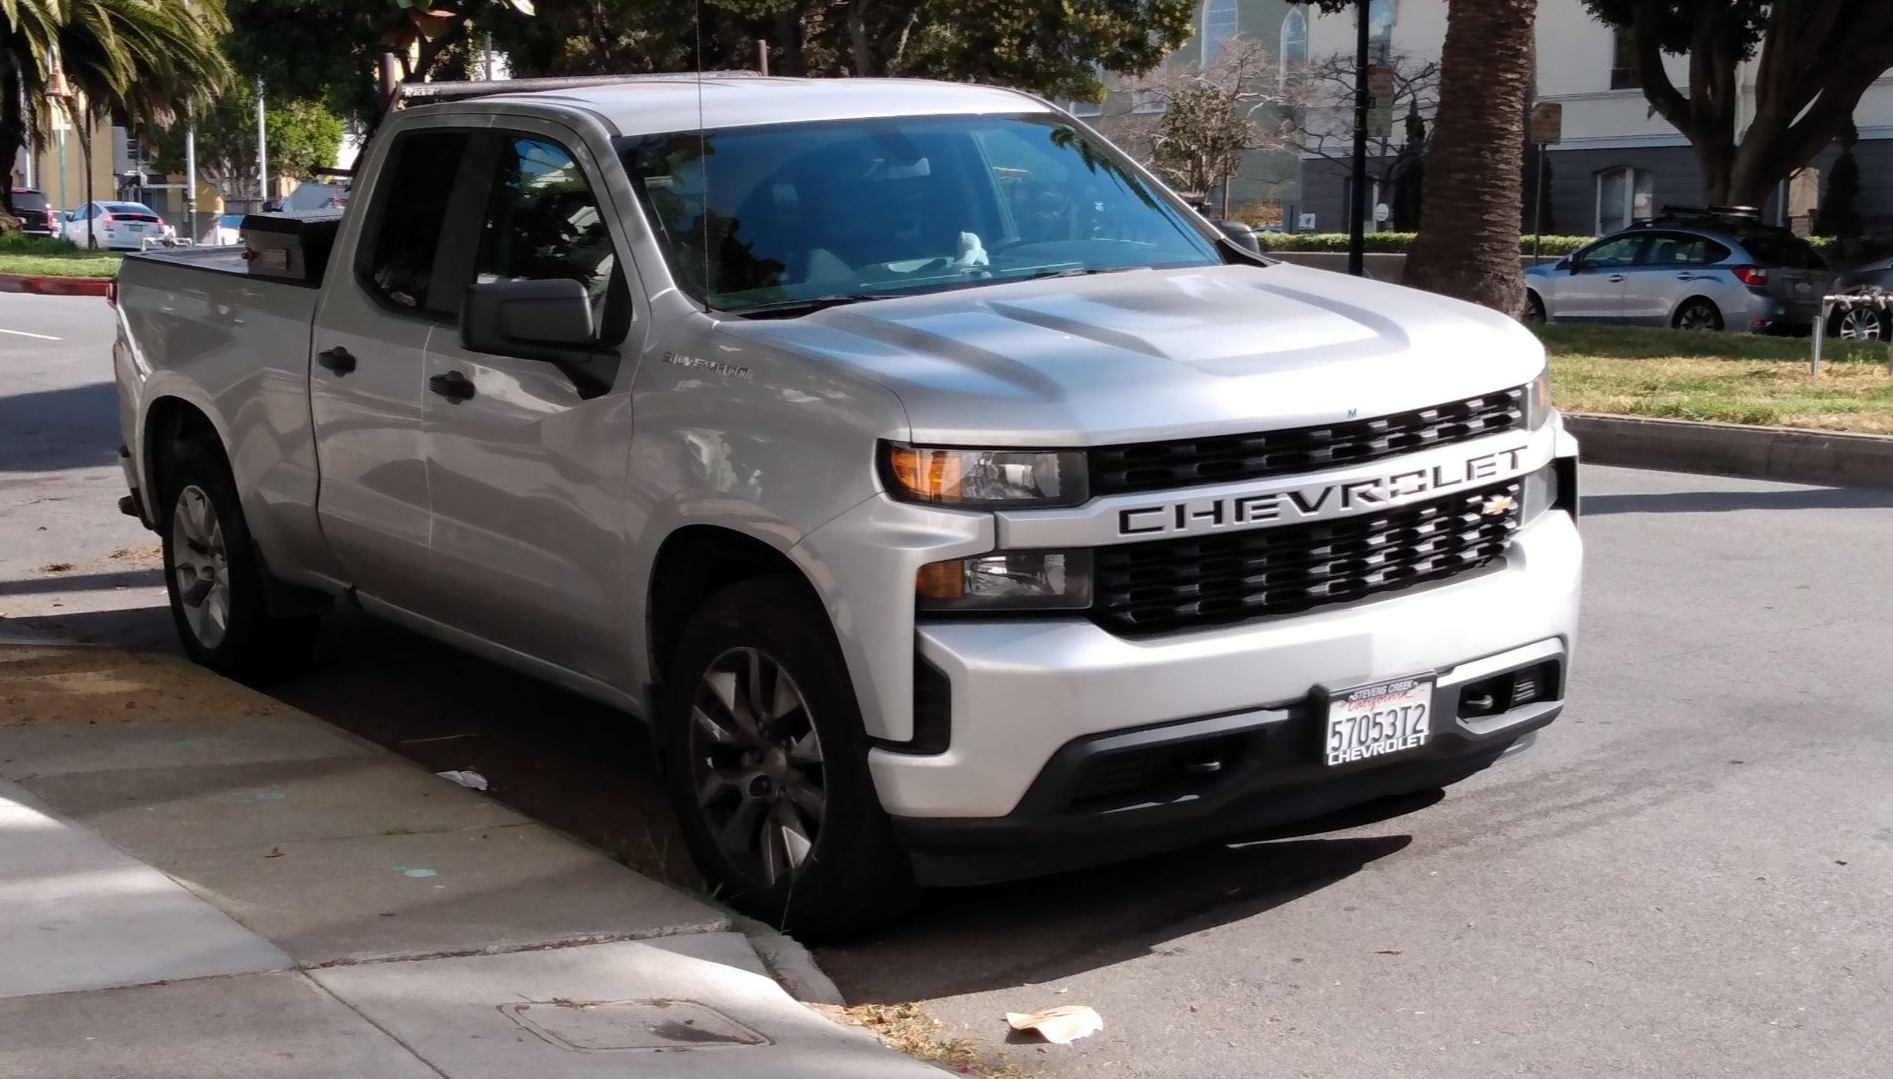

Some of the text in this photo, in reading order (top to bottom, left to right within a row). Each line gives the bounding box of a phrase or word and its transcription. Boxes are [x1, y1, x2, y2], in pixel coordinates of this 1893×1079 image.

[1347, 408, 1357, 419] M
[1118, 445, 1529, 536] CHEVROLET
[1353, 680, 1413, 700] STEVENS CREEK
[1331, 703, 1426, 752] 57053T2
[1327, 730, 1429, 766] CHEVROLET
